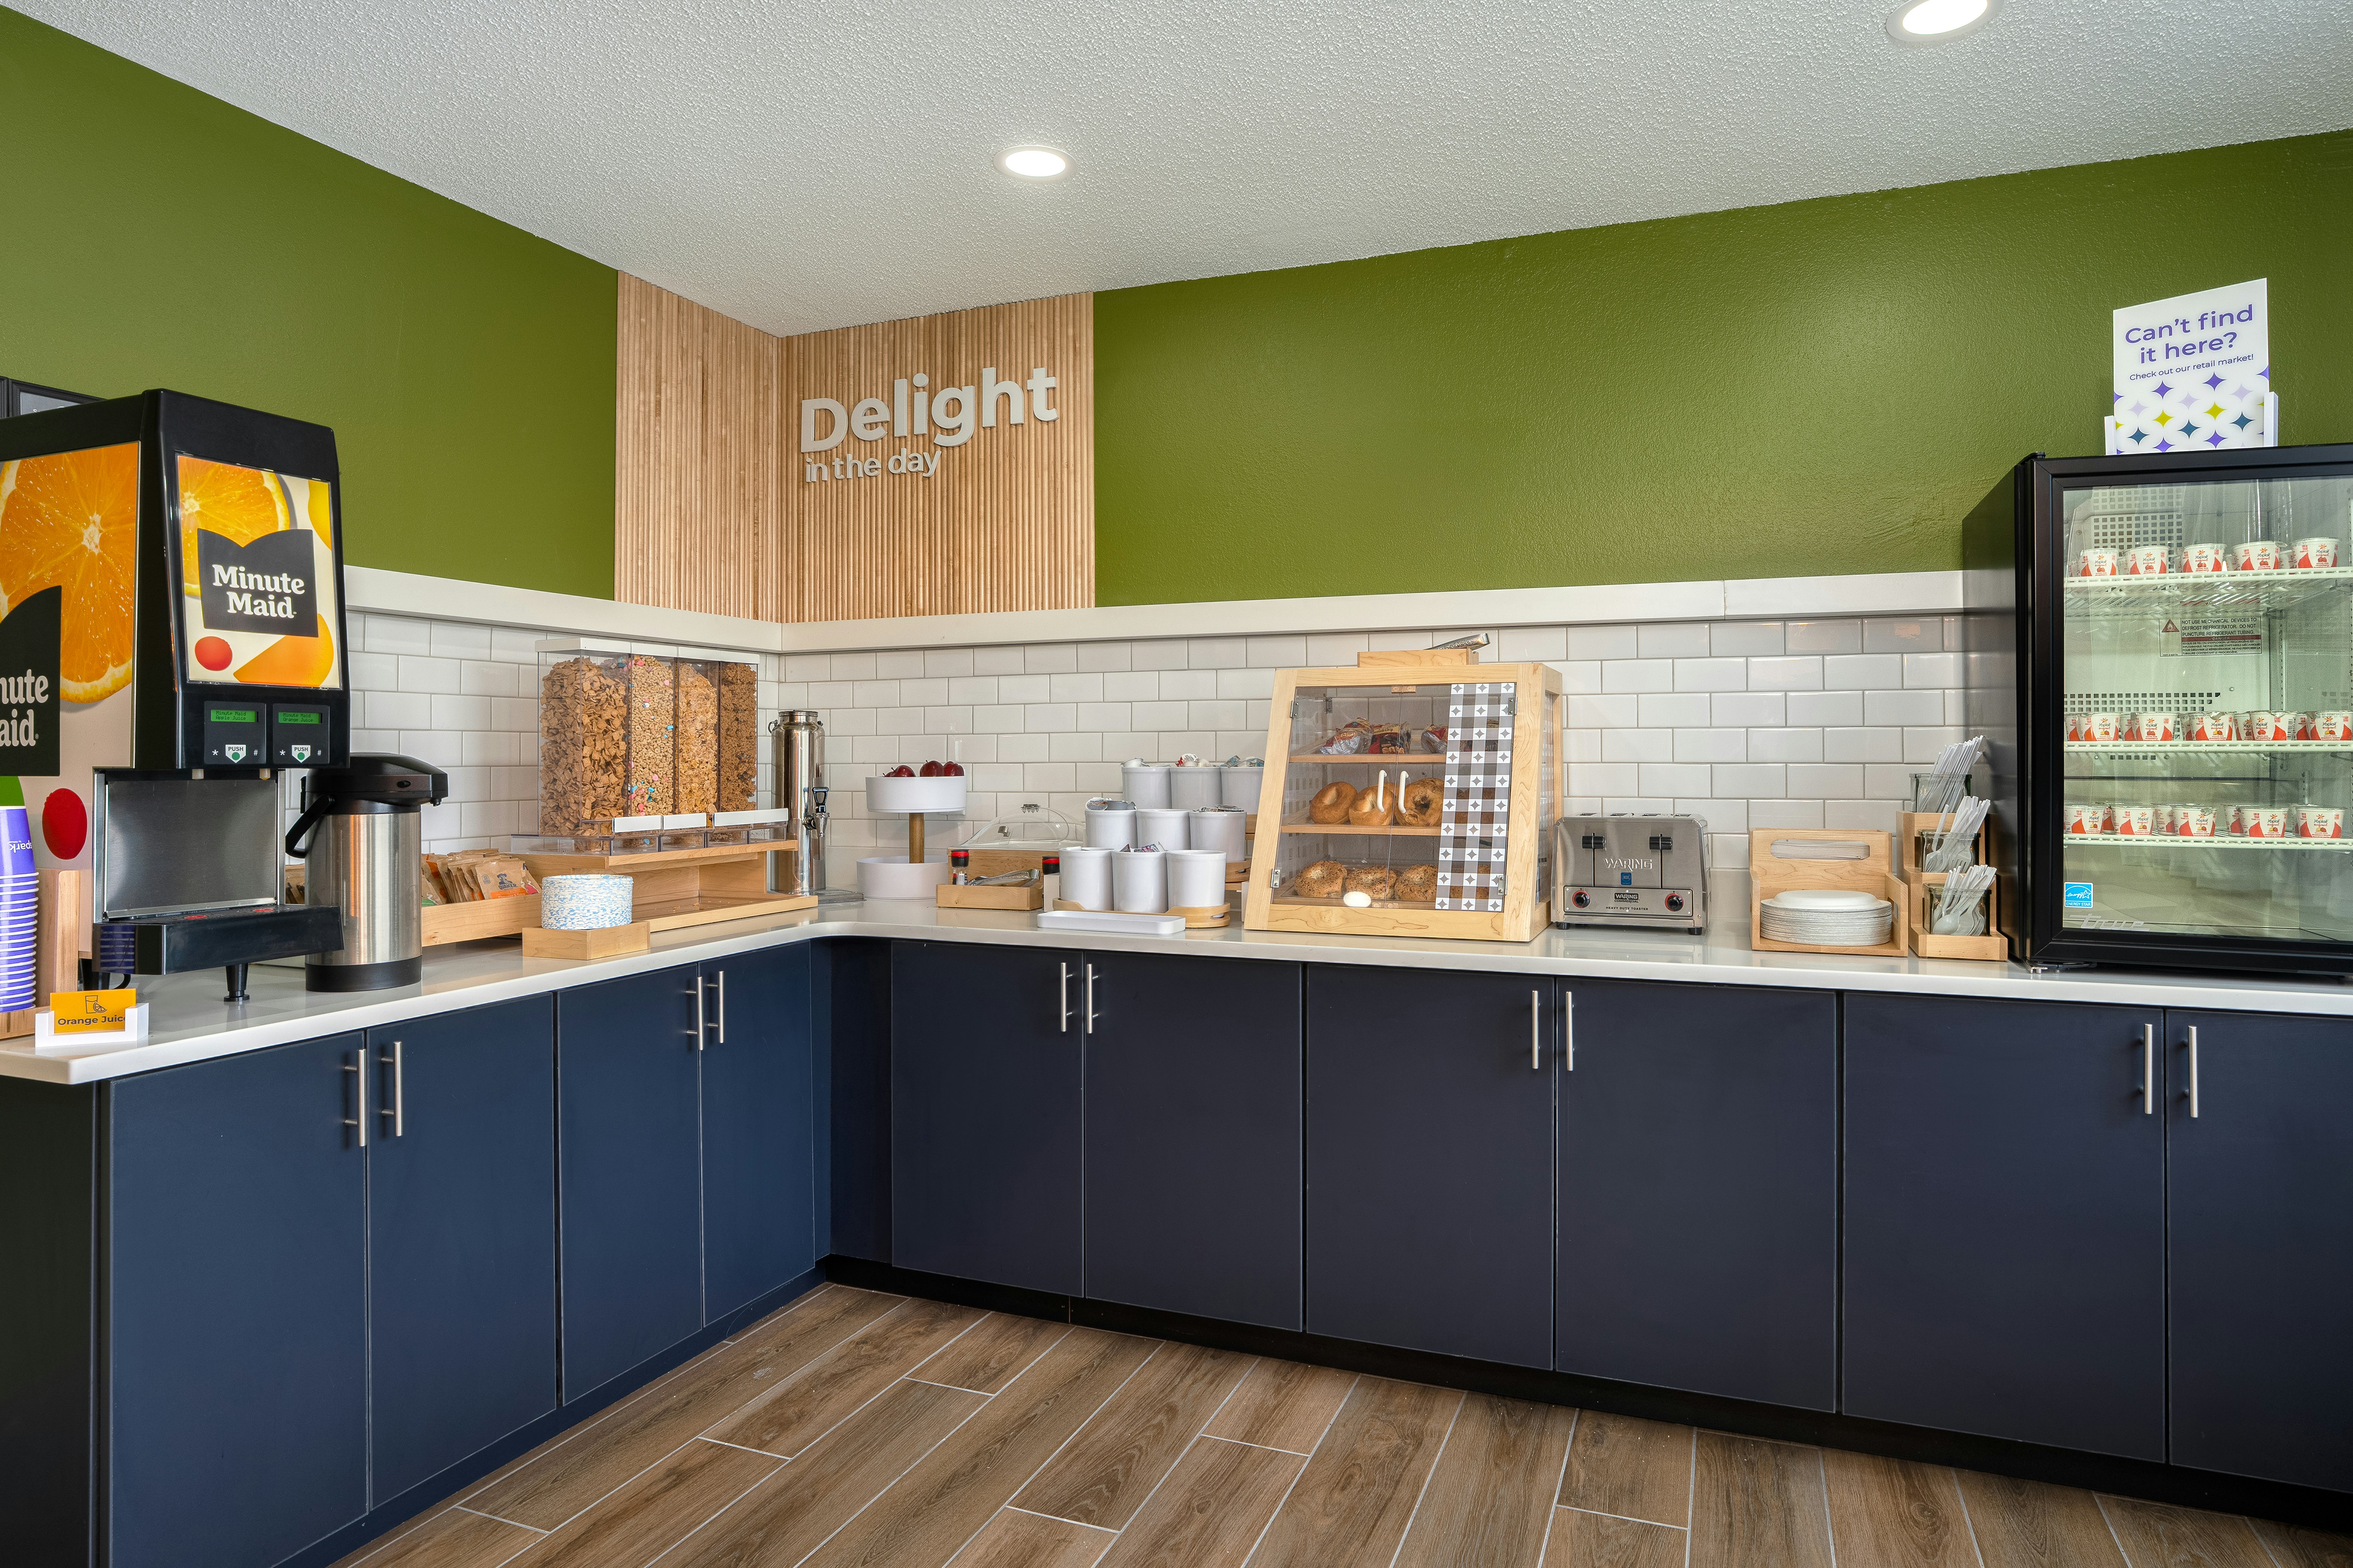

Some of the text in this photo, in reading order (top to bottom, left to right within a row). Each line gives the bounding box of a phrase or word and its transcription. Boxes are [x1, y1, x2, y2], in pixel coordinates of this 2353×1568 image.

[2125, 304, 2253, 343] Can't find
[2141, 332, 2237, 364] it here?
[2130, 371, 2156, 381] Check
[2193, 360, 2215, 370] retail
[2218, 354, 2254, 366] market!
[801, 367, 1059, 453] Delight
[806, 448, 942, 483] in the day
[212, 564, 305, 595] Minute
[226, 591, 295, 619] Maid
[0, 669, 49, 704] nute
[0, 709, 36, 747] aid
[8, 840, 32, 853] spark
[1604, 858, 1652, 872] WARING
[2069, 913, 2150, 932] true
